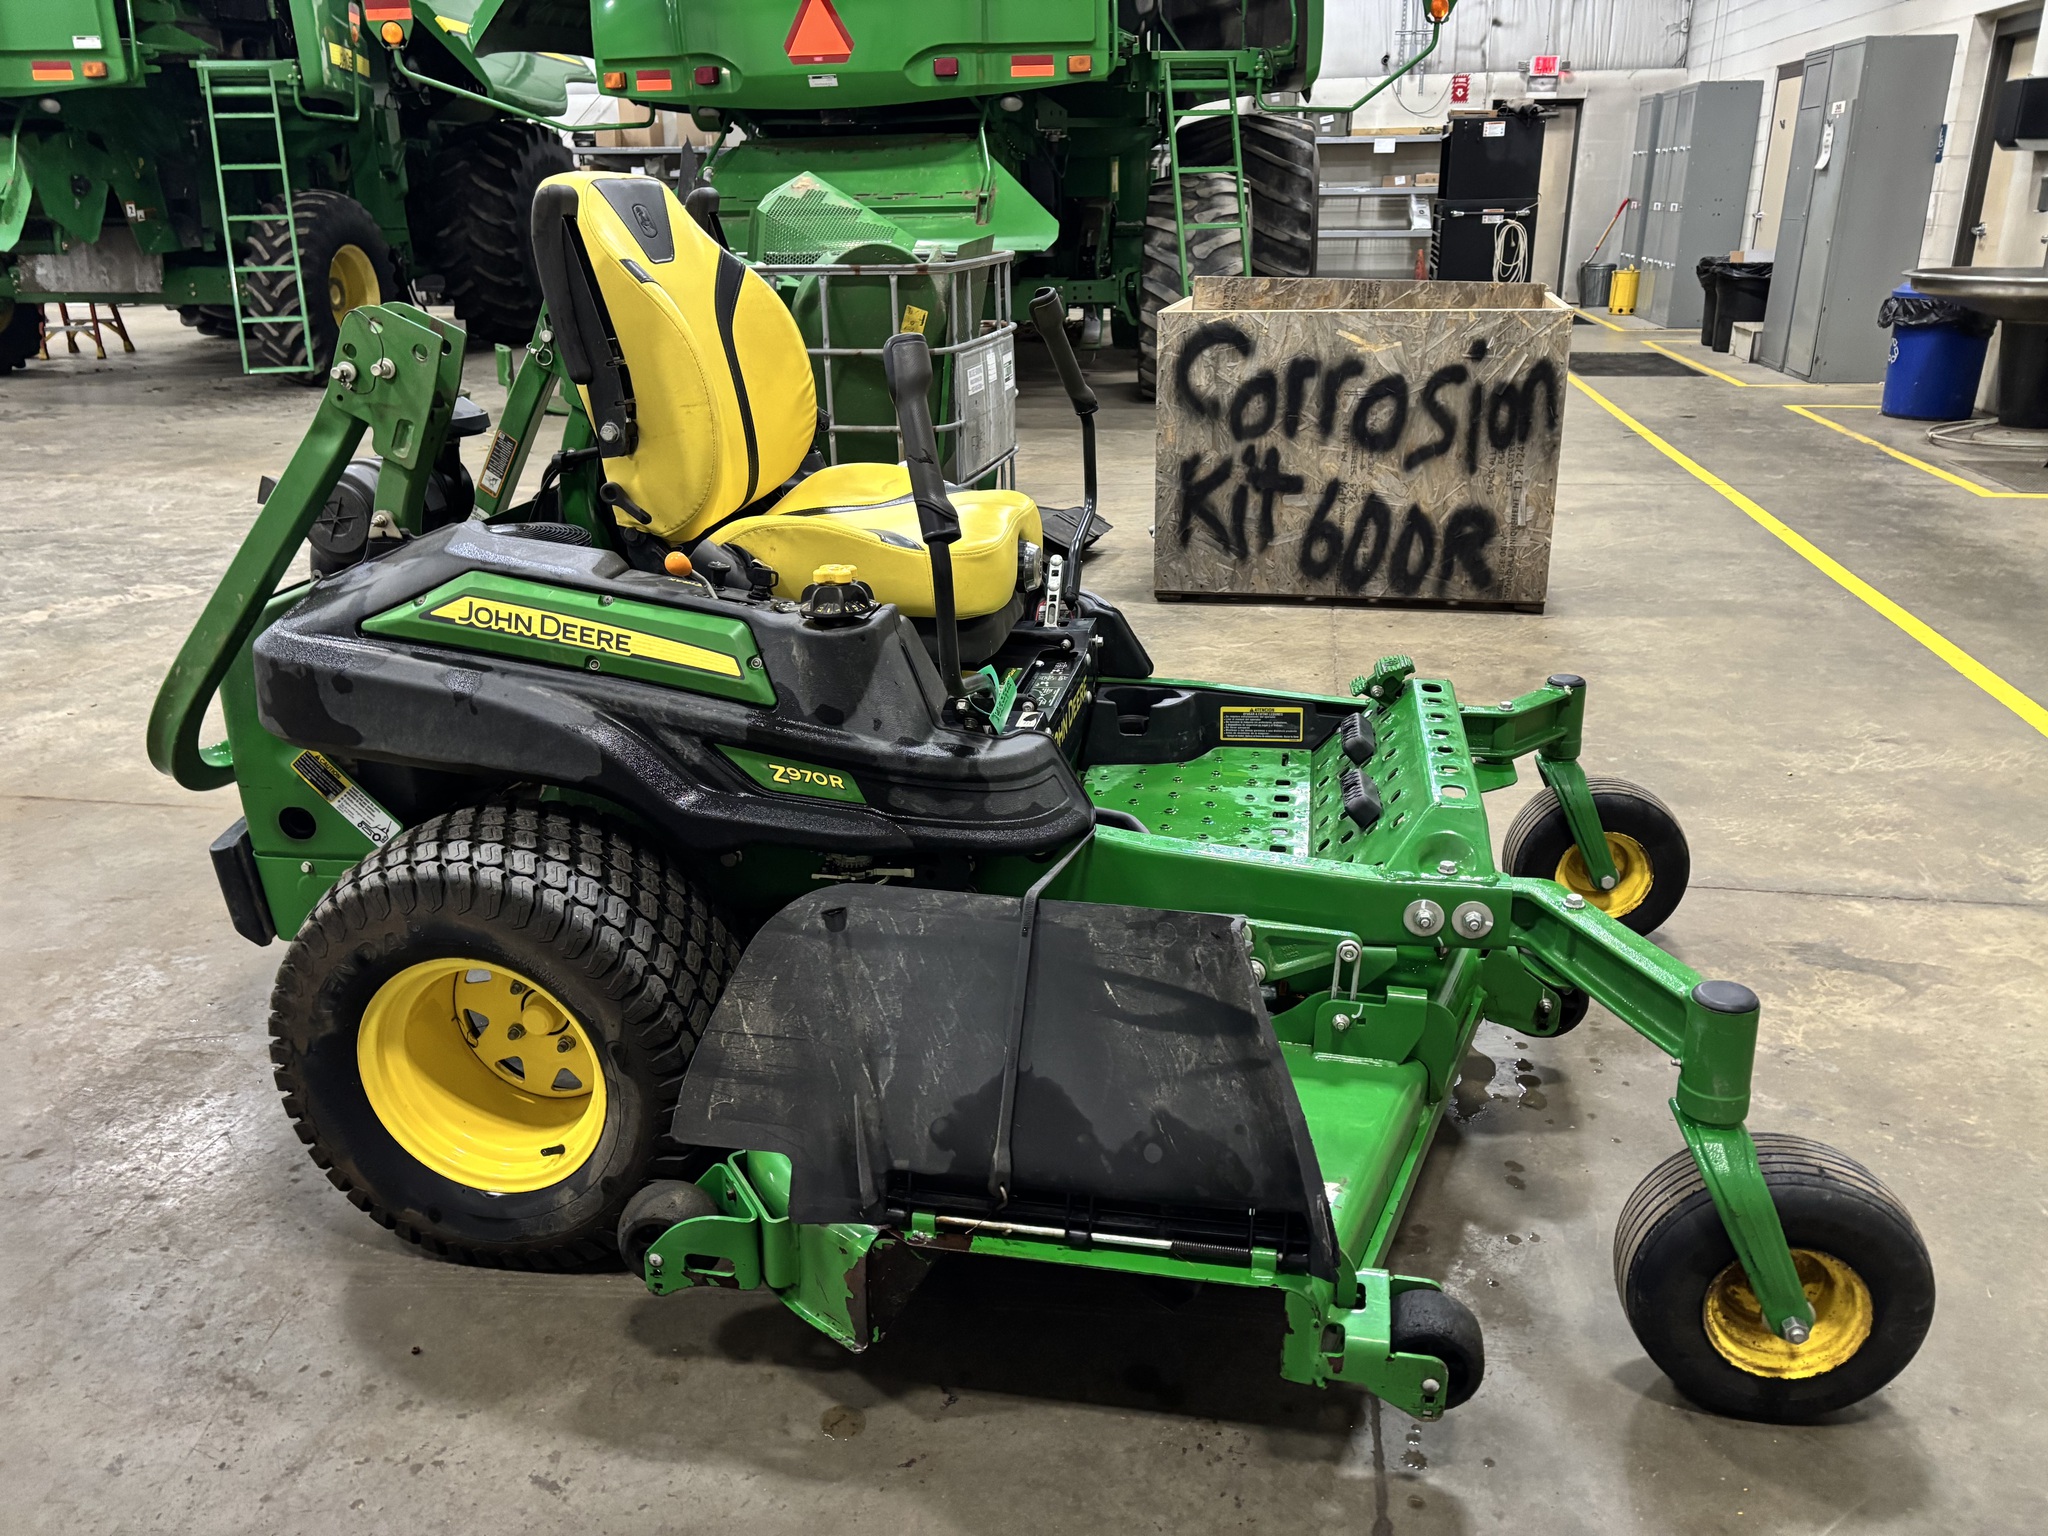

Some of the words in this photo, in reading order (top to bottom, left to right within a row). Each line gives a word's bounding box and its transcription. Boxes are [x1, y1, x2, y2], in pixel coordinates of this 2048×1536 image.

[1486, 469, 1496, 496] SPACE
[1513, 446, 1525, 491] 11-21-24
[1179, 445, 1304, 560] Kit
[1301, 477, 1500, 596] 600R
[458, 600, 533, 634] JOHN
[539, 616, 633, 655] DEERE
[1054, 713, 1068, 748] OHN
[319, 758, 342, 779] CAUTION
[768, 763, 847, 791] Z970R
